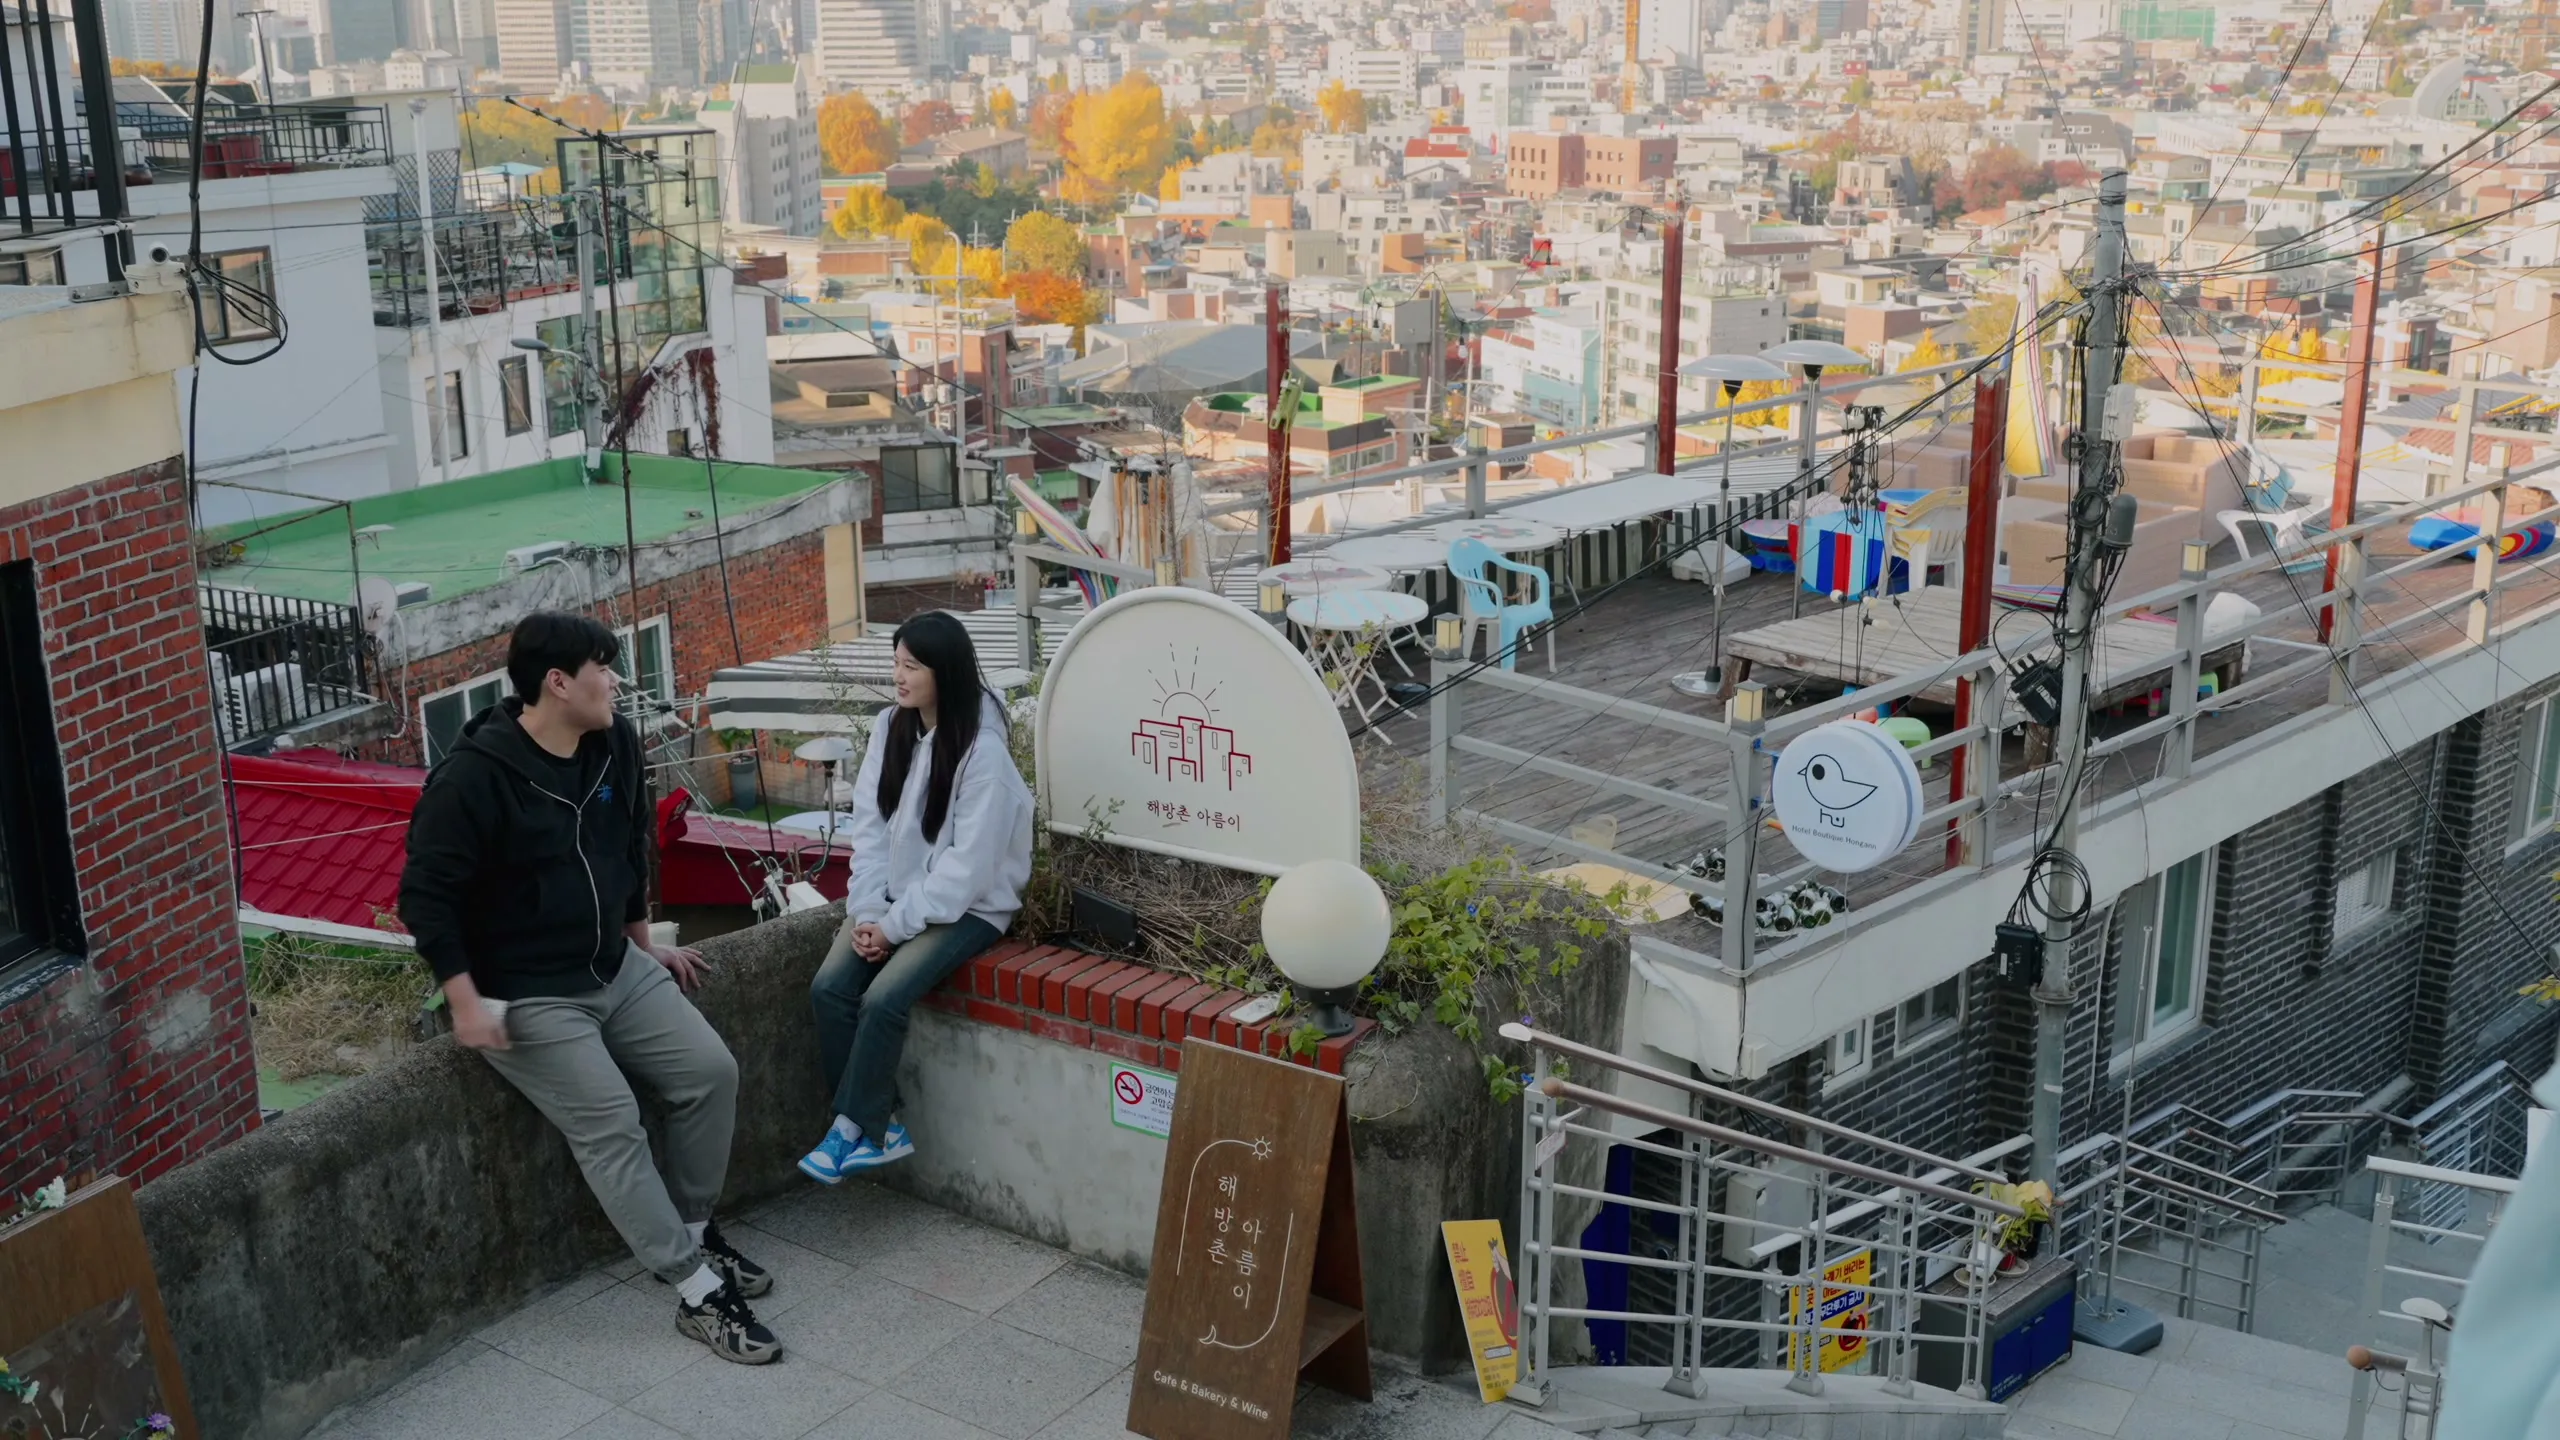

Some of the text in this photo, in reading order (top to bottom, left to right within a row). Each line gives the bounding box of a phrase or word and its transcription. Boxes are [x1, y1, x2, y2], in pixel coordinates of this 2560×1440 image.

[1146, 799, 1240, 833] 해방촌 아름이
[1792, 824, 1811, 835] Hotel
[1812, 829, 1844, 843] Boutique
[1207, 1174, 1238, 1265] 해방촌
[1232, 1218, 1262, 1310] 아름이
[1843, 1258, 1866, 1277] 버리는
[1153, 1370, 1269, 1420] Cafe & Bakery & Wine
